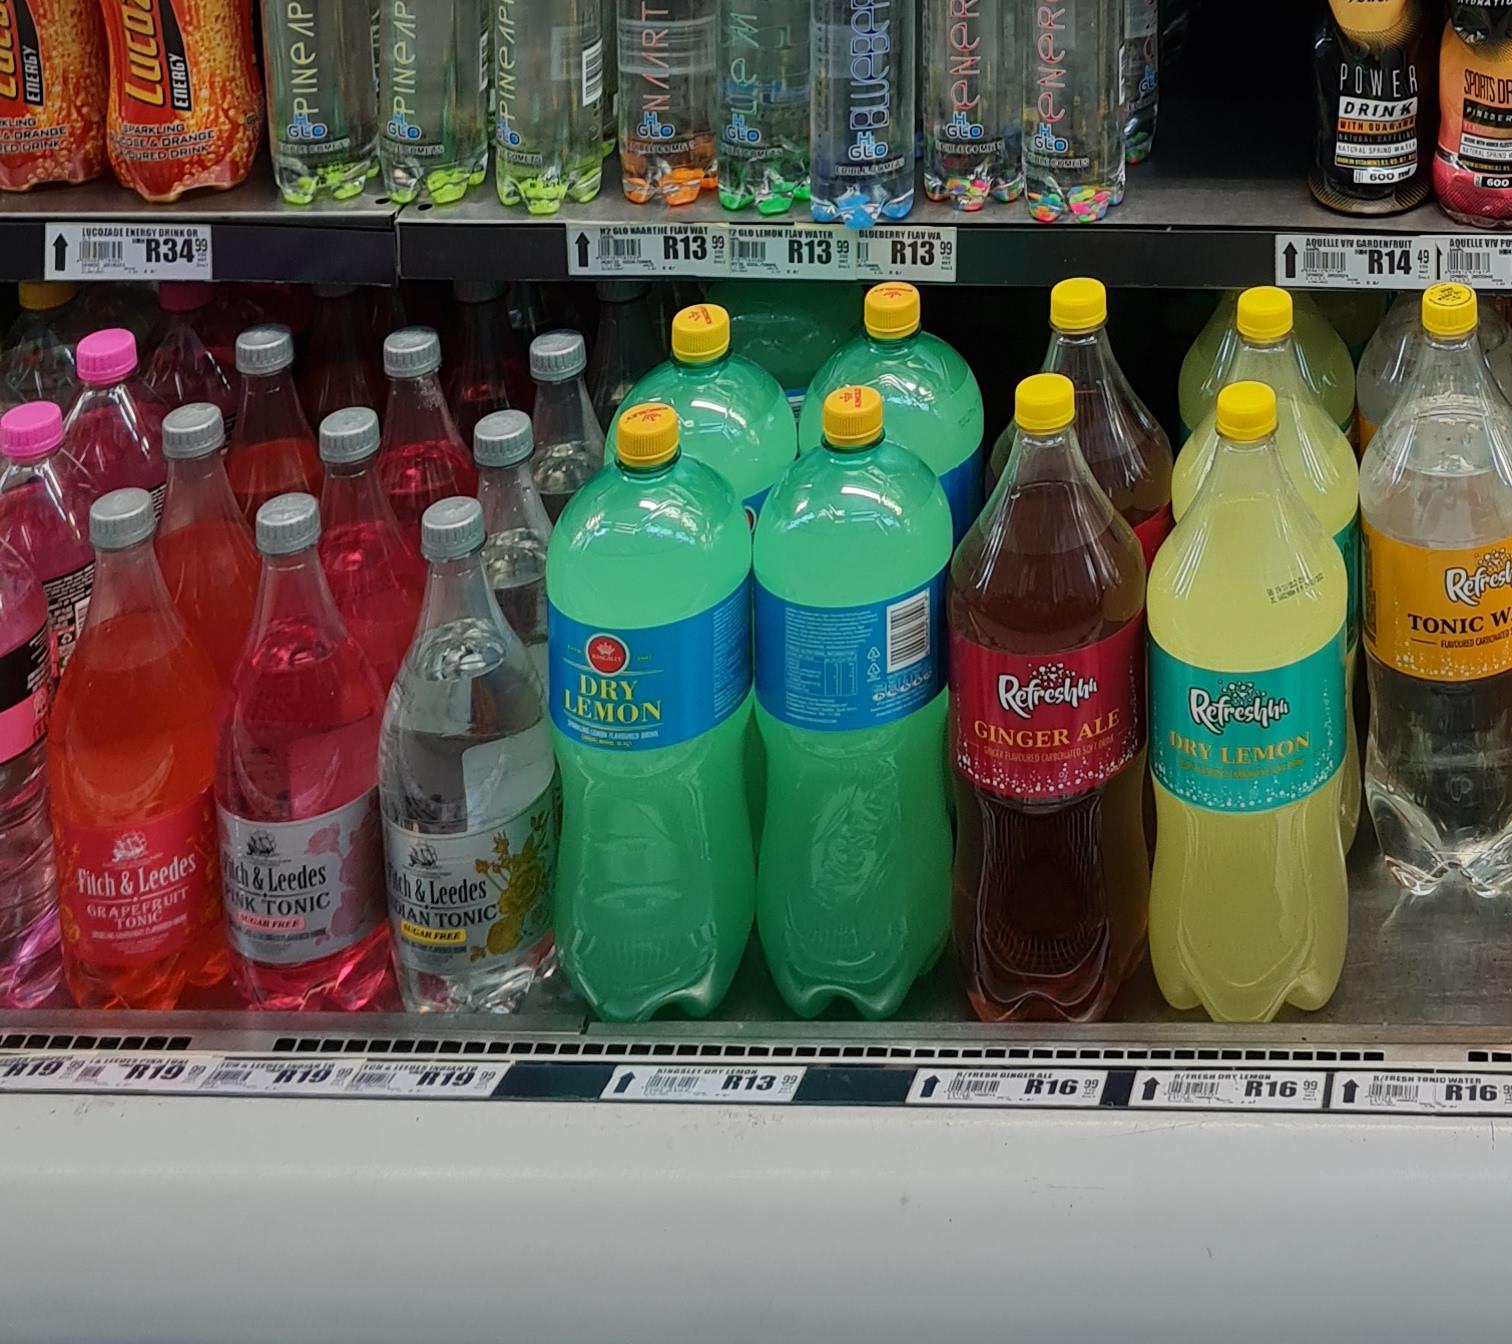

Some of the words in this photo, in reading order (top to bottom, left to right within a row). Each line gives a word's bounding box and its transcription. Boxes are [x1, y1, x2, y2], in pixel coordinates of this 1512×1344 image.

[168, 53, 191, 110] ENERGY
[146, 239, 193, 264] R34
[195, 239, 207, 253] 99
[1368, 249, 1411, 273] R14
[1417, 250, 1429, 263] 49
[1408, 612, 1483, 636] TONIC
[580, 675, 638, 701] DRY
[564, 689, 662, 723] LEMON
[974, 720, 1069, 748] GINGER
[1077, 708, 1120, 742] ALE
[1169, 732, 1214, 761] DRY
[1220, 732, 1310, 764] LEMON
[77, 861, 115, 897] Fitch
[120, 870, 134, 893] &
[137, 852, 196, 890] Leedes
[268, 893, 330, 914] TONIC
[723, 1074, 775, 1092] R13
[1244, 1082, 1297, 1098] R16
[1303, 1081, 1317, 1091] 99
